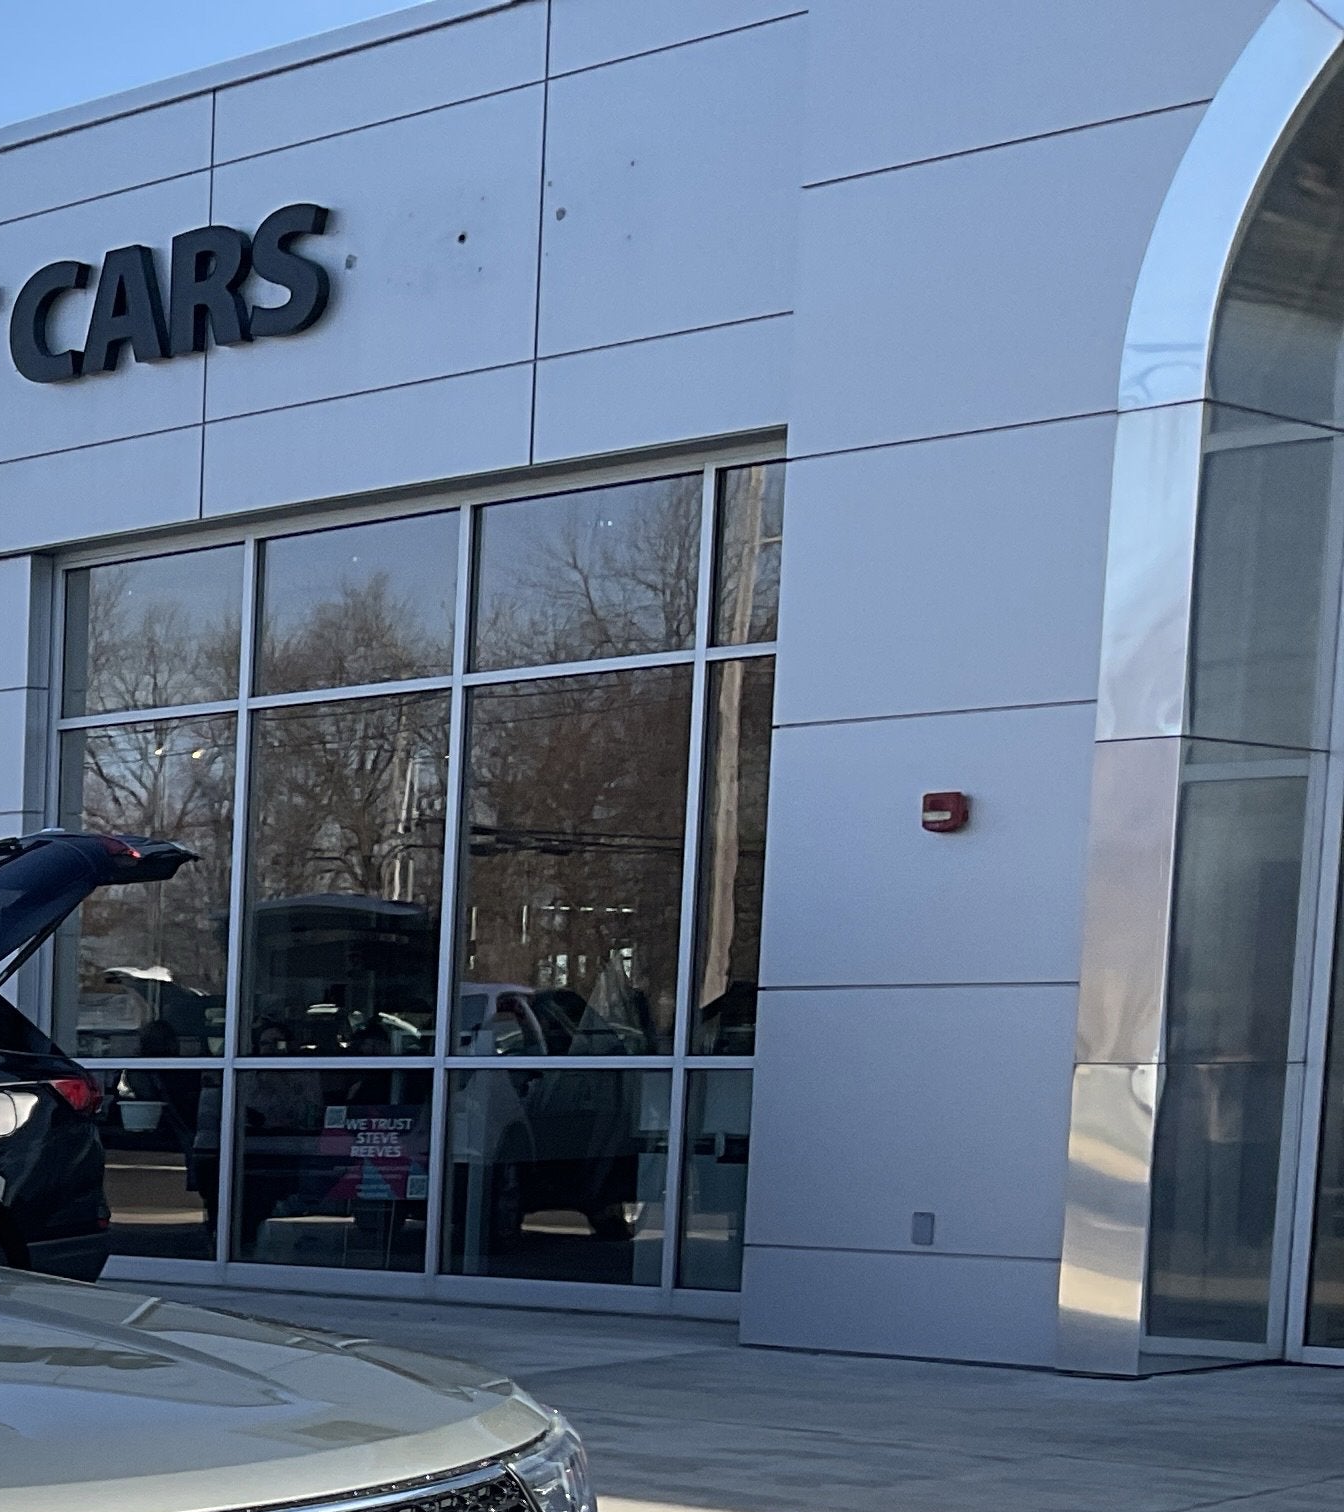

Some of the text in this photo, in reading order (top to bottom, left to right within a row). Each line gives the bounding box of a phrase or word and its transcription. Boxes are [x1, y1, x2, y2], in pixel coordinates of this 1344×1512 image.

[10, 203, 330, 384] CARS
[345, 1118, 412, 1130] WE TRUST
[355, 1132, 399, 1144] STEVE
[350, 1146, 401, 1157] REEVES
